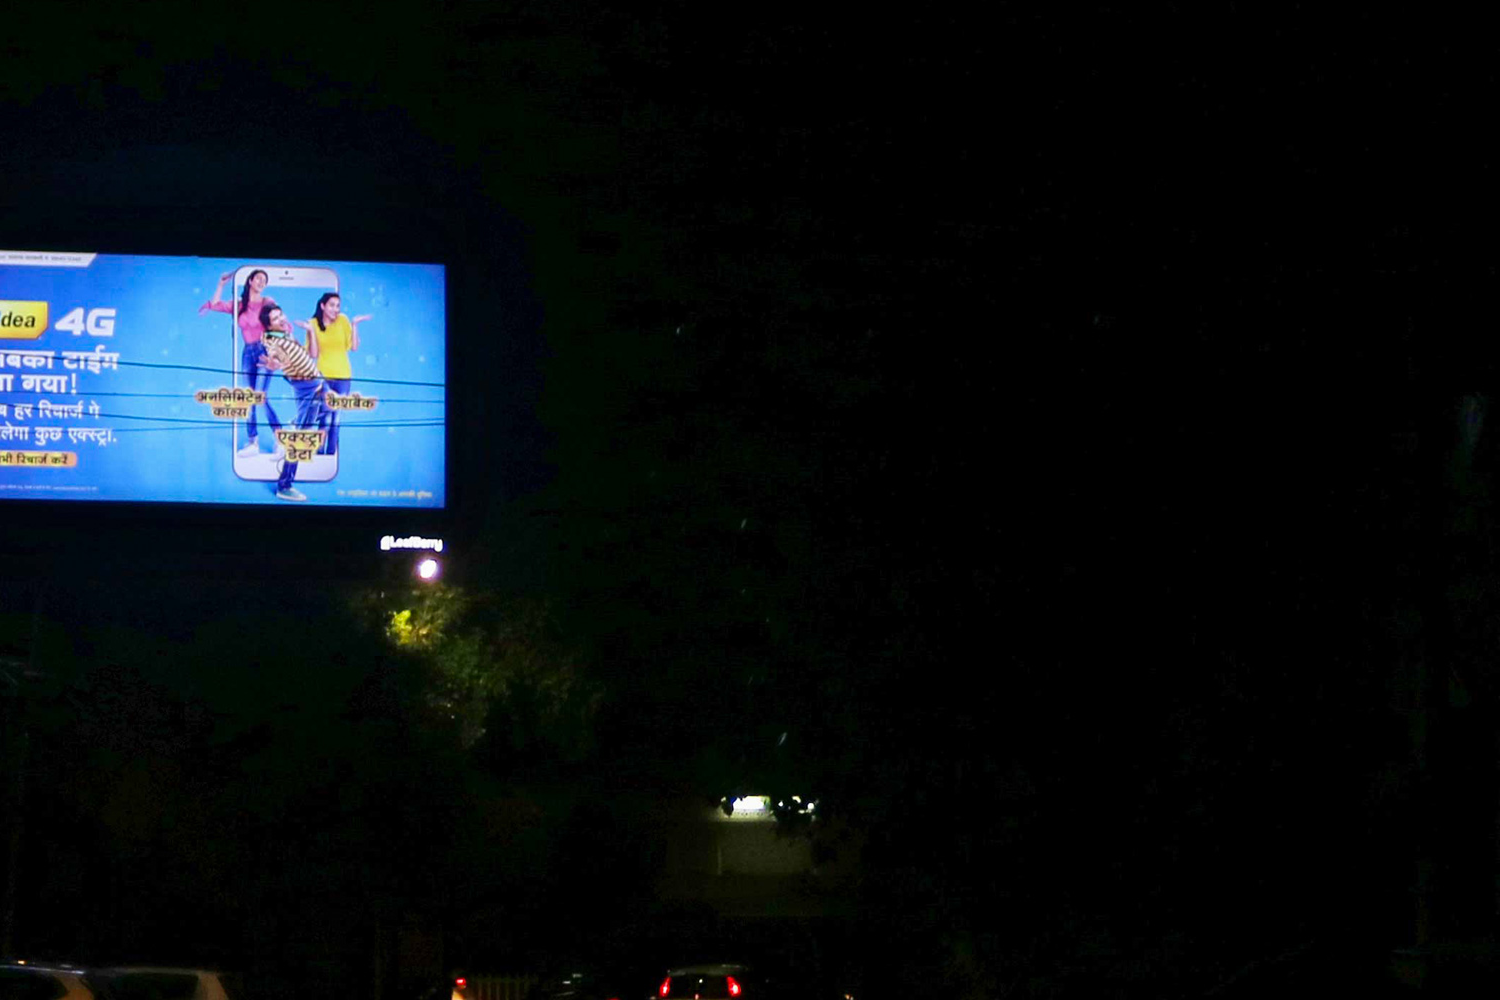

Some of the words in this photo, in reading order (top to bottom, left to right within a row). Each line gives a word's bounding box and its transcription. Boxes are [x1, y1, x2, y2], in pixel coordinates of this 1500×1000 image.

[55, 307, 116, 336] 4G
[62, 344, 119, 374] टाईम
[21, 373, 77, 394] गया!
[14, 403, 33, 420] हर
[38, 399, 83, 419] रिचार्ज
[327, 393, 375, 409] कैशबैक
[35, 426, 62, 446] कुछ
[277, 430, 322, 446] एक्स्ट्रा
[16, 452, 48, 464] रिचार्ज
[50, 453, 69, 465] करें
[287, 447, 312, 461] डेटा
